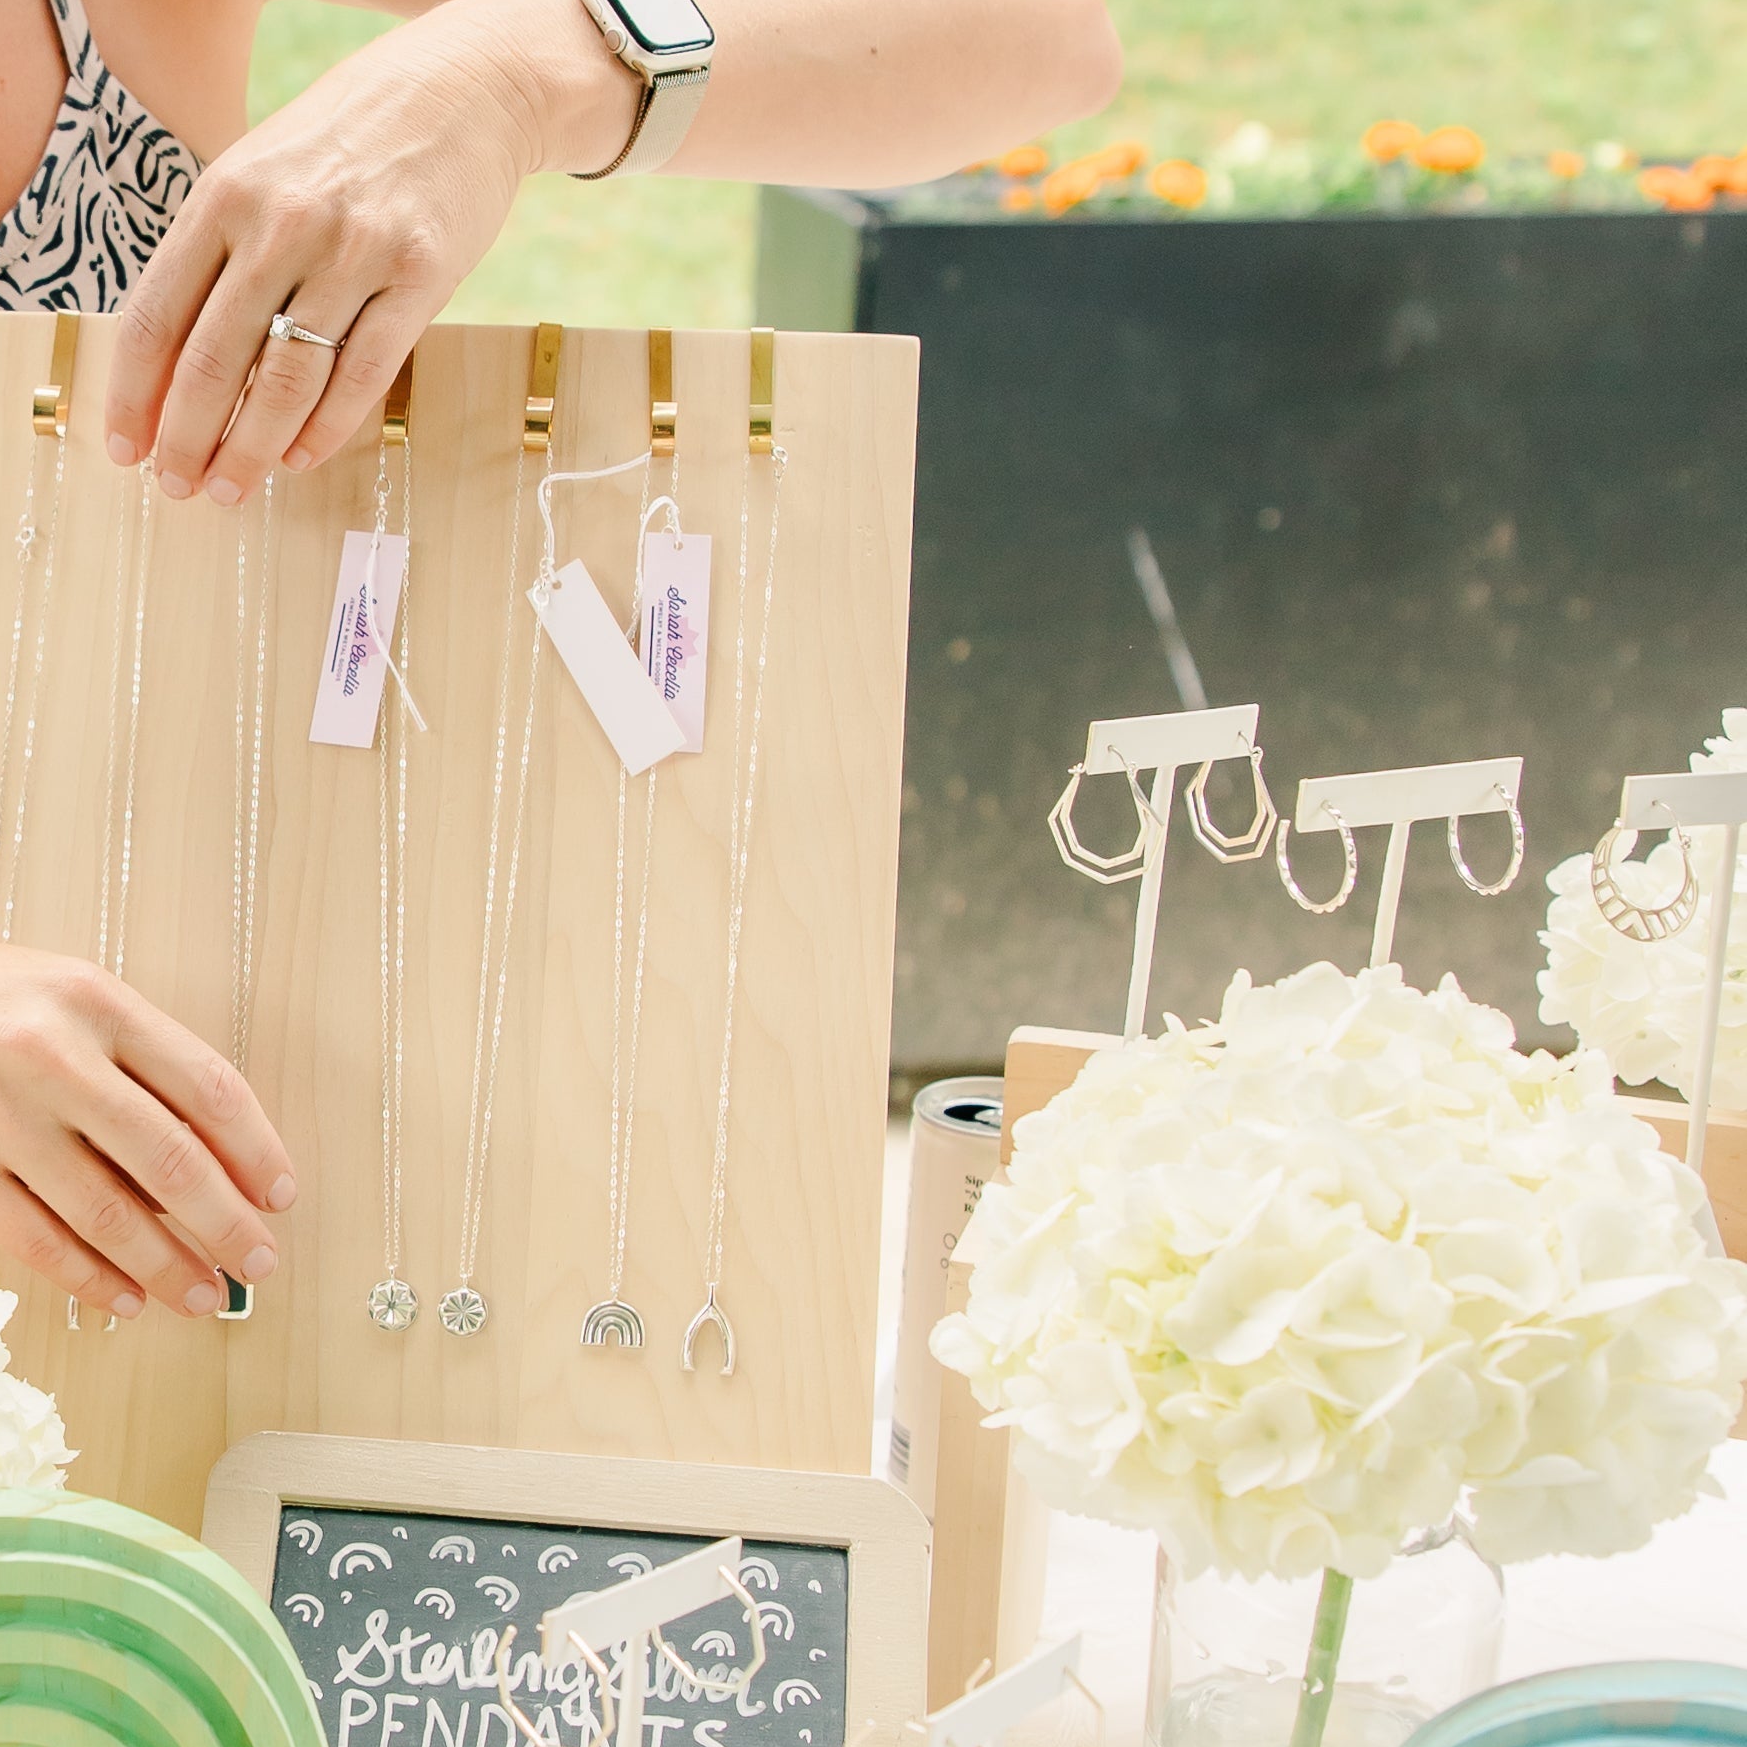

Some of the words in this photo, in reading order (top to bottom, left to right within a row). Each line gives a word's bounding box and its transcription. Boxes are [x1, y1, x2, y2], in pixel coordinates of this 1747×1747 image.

[667, 584, 687, 642] Sarah
[343, 643, 366, 698] Cecelia
[664, 646, 684, 702] Cecelia
[333, 1609, 593, 1726] Sterling
